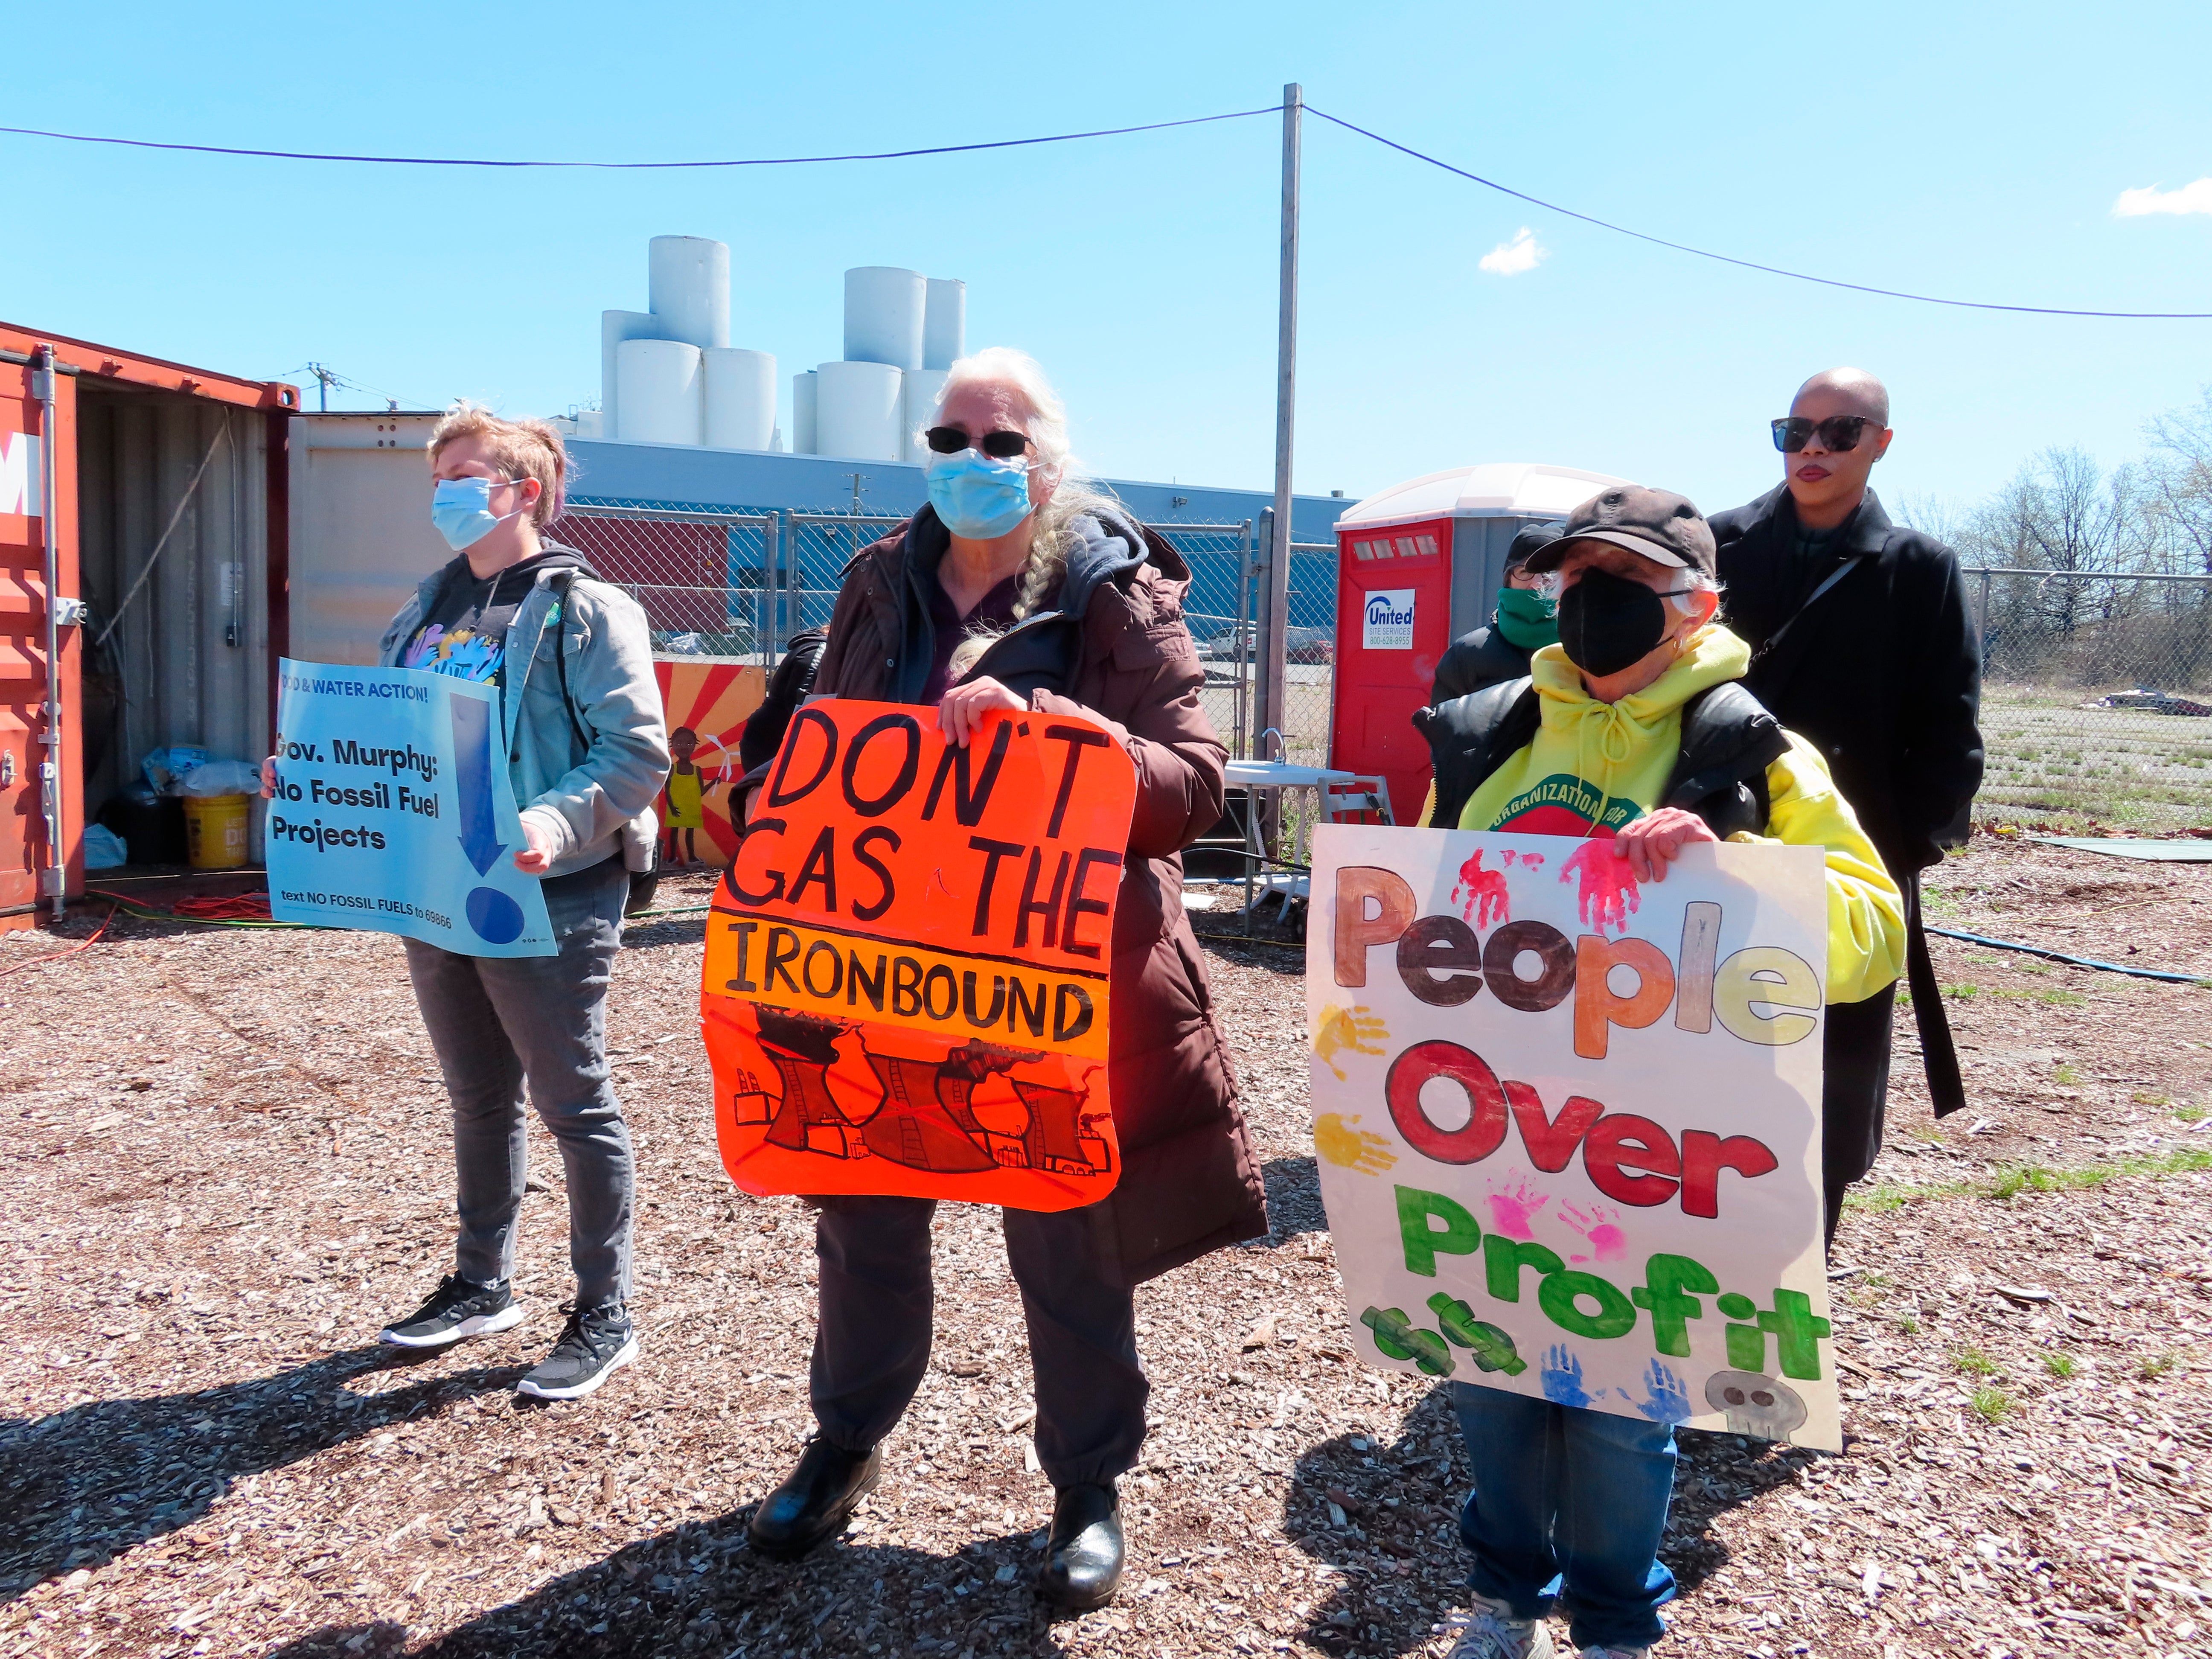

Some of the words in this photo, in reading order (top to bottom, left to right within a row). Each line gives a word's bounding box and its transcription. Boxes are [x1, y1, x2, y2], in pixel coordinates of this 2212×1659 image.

[1370, 607, 1412, 625] United
[1370, 637, 1409, 645] 800-628-8955
[282, 674, 300, 690] OOD
[303, 678, 310, 692] &
[312, 678, 365, 697] WATER
[368, 683, 428, 704] ACTION!
[332, 739, 438, 782] Murphy:
[768, 709, 1110, 838] DON'T
[310, 779, 390, 809] Fossil
[398, 786, 439, 819] Fuel
[1493, 783, 1599, 827] ORGANIZATION
[1602, 806, 1628, 824] FOR
[272, 815, 386, 853] Projects
[281, 889, 304, 902] text
[307, 892, 326, 904] NO
[330, 894, 375, 909] FOSSIL
[378, 899, 413, 915] FUELS
[415, 907, 423, 918] to
[426, 909, 452, 929] 69866
[724, 818, 902, 921] GAS
[968, 836, 1122, 959] THE
[725, 922, 1093, 1042] IRONBOUND
[1334, 866, 1822, 1059] People
[1385, 1040, 1778, 1218] Over
[1394, 1184, 1831, 1381] Profit
